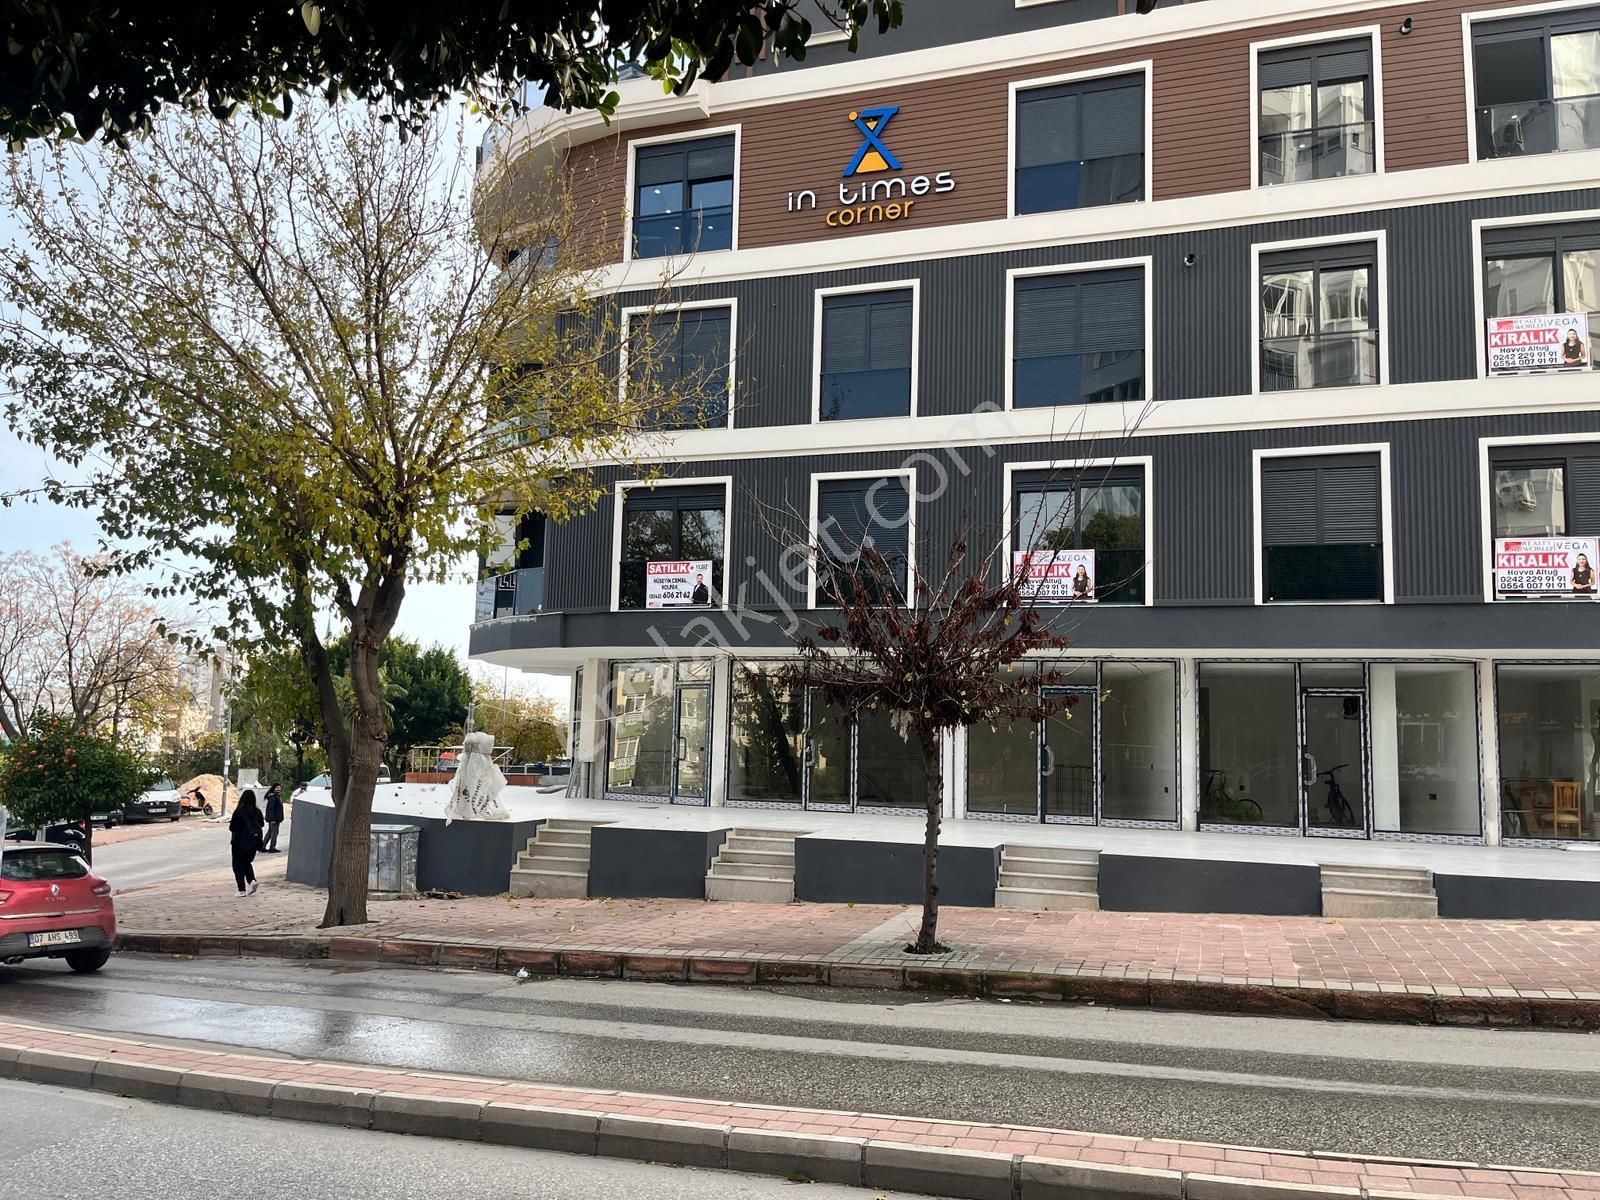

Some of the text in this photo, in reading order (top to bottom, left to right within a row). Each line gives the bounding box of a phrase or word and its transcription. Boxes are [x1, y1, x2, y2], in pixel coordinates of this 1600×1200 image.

[787, 171, 956, 212] in times
[825, 199, 914, 227] corner
[1547, 317, 1579, 326] VEGA
[1493, 353, 1516, 361] 0242
[1518, 352, 1535, 360] 229
[1493, 360, 1516, 368] 0554
[1557, 542, 1589, 550] VEGA
[649, 564, 687, 573] SATILIK
[34, 934, 44, 943] 07
